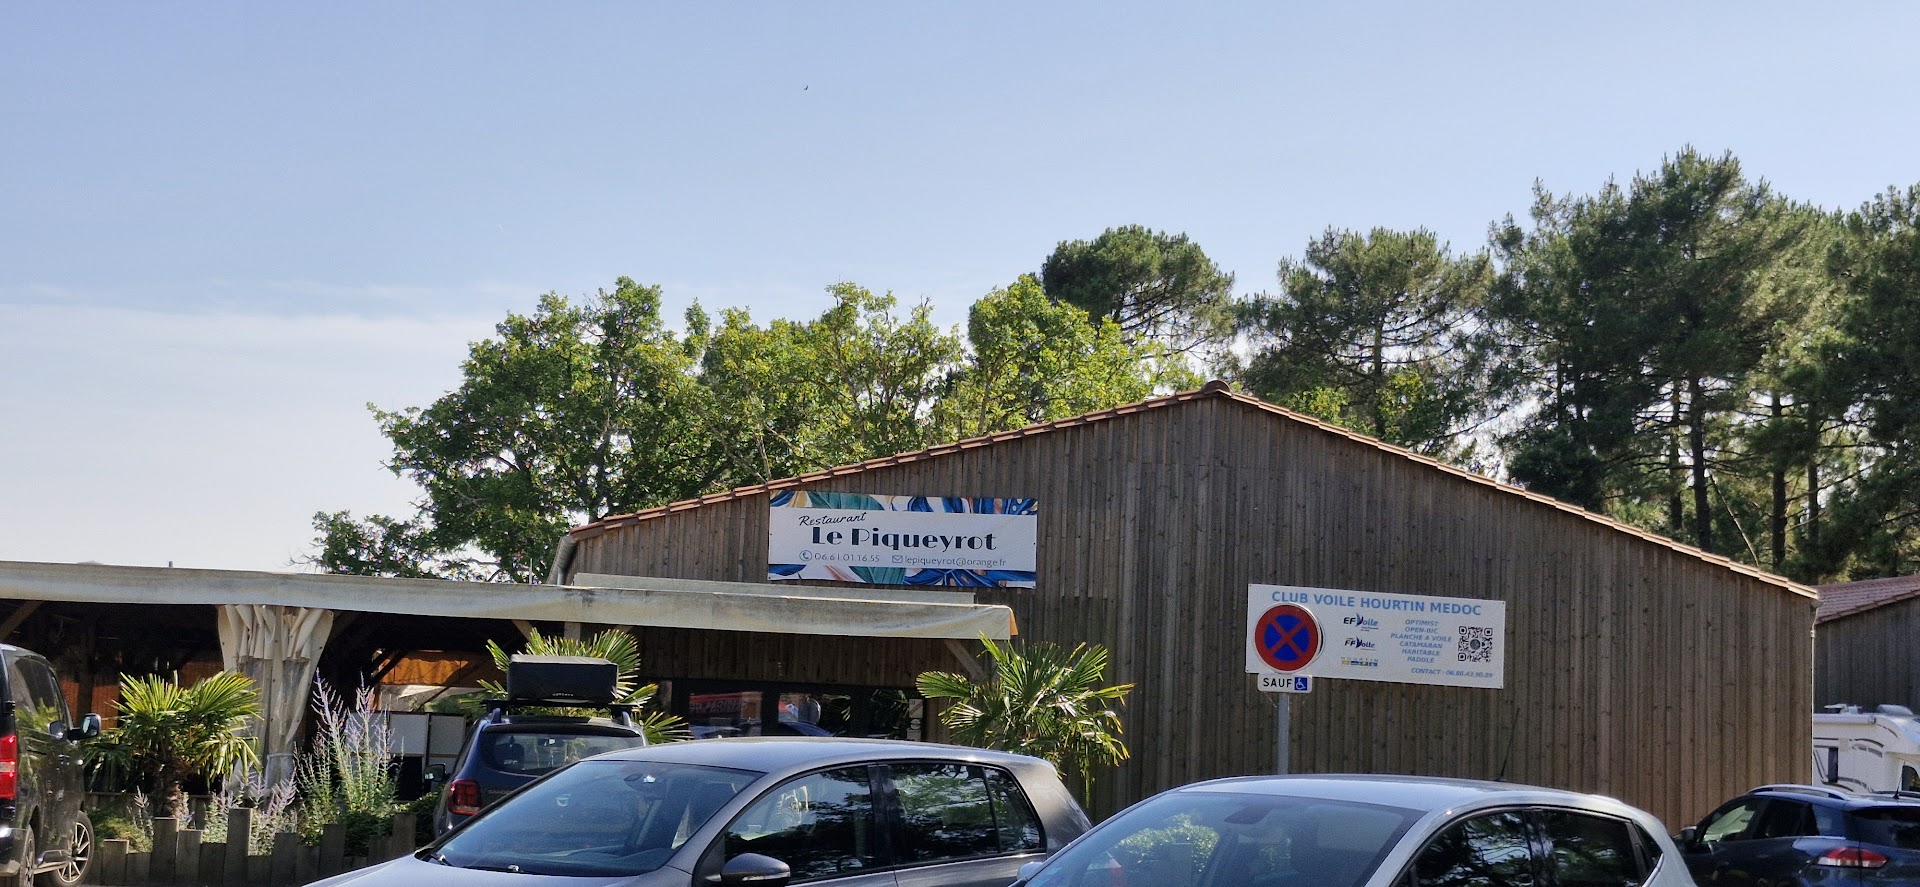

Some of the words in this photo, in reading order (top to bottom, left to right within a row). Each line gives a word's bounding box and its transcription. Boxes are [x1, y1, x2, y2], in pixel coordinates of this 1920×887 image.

[799, 511, 867, 527] Restaurant
[812, 526, 843, 546] Le
[851, 527, 997, 553] Piqueyrot
[814, 552, 880, 562] 06.61.01.16.55
[905, 556, 1007, 568] lepiqueyrot@orange.fr
[1272, 591, 1308, 603] CLUB
[1314, 593, 1355, 607] VOILE
[1361, 597, 1425, 612] HOURTIN
[1430, 602, 1482, 616] MEDOC
[1405, 619, 1439, 627] OPTIMIST
[1399, 641, 1443, 649] CATAMARAN
[1401, 648, 1441, 656] HABITABLE
[1406, 656, 1435, 664] PADDLE
[1411, 667, 1441, 675] CONTACT
[1263, 677, 1292, 688] SAUF
